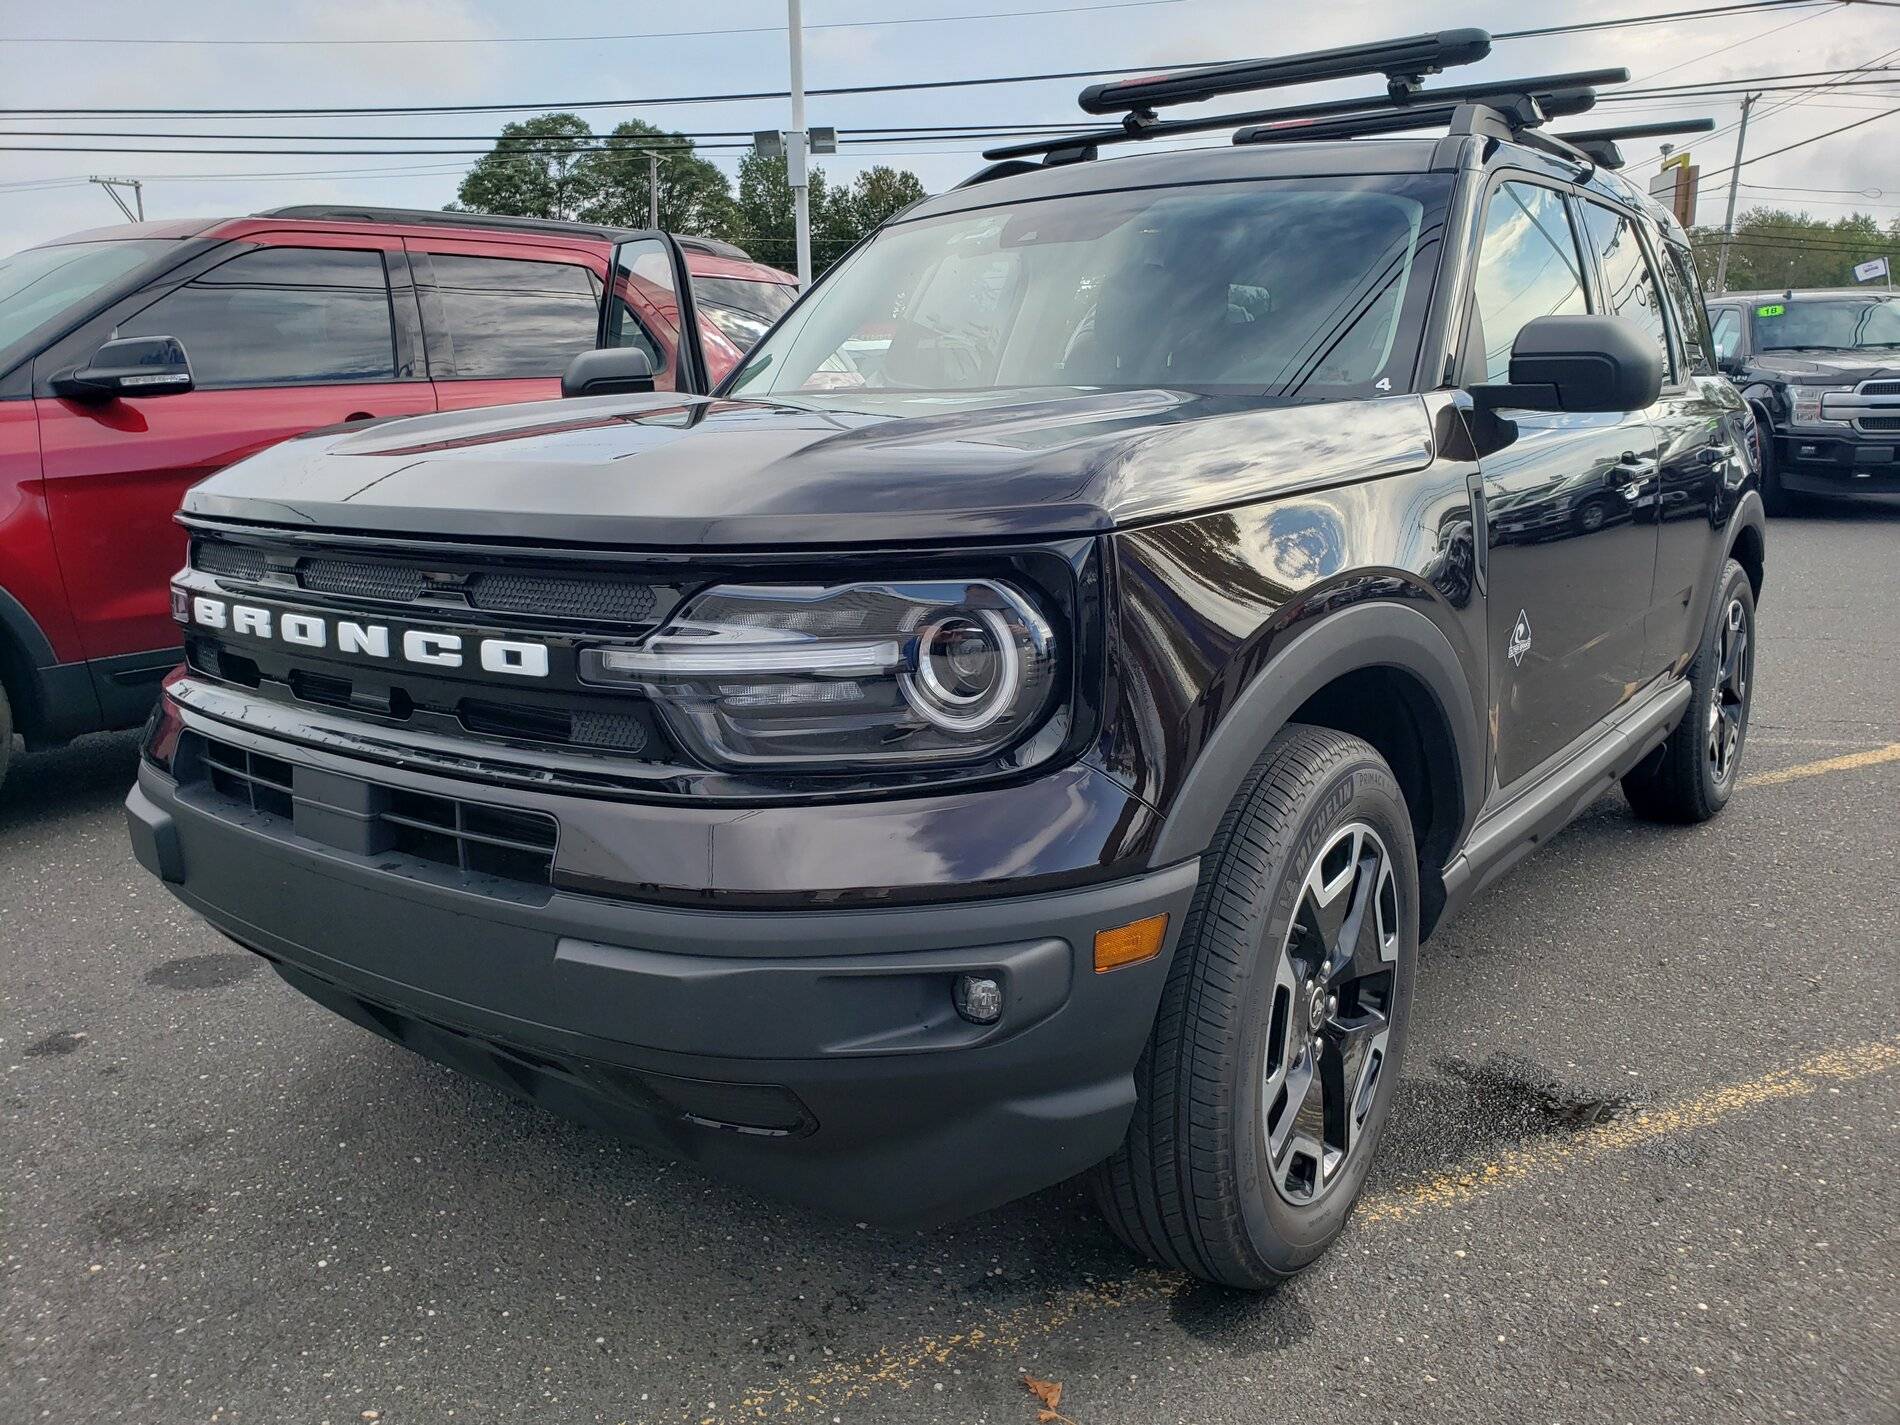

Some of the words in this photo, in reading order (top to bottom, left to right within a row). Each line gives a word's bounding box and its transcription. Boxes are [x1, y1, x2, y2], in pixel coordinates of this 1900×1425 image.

[1375, 377, 1392, 391] 4
[193, 596, 549, 677] BRONCO
[1294, 780, 1352, 876] MICHELIN
